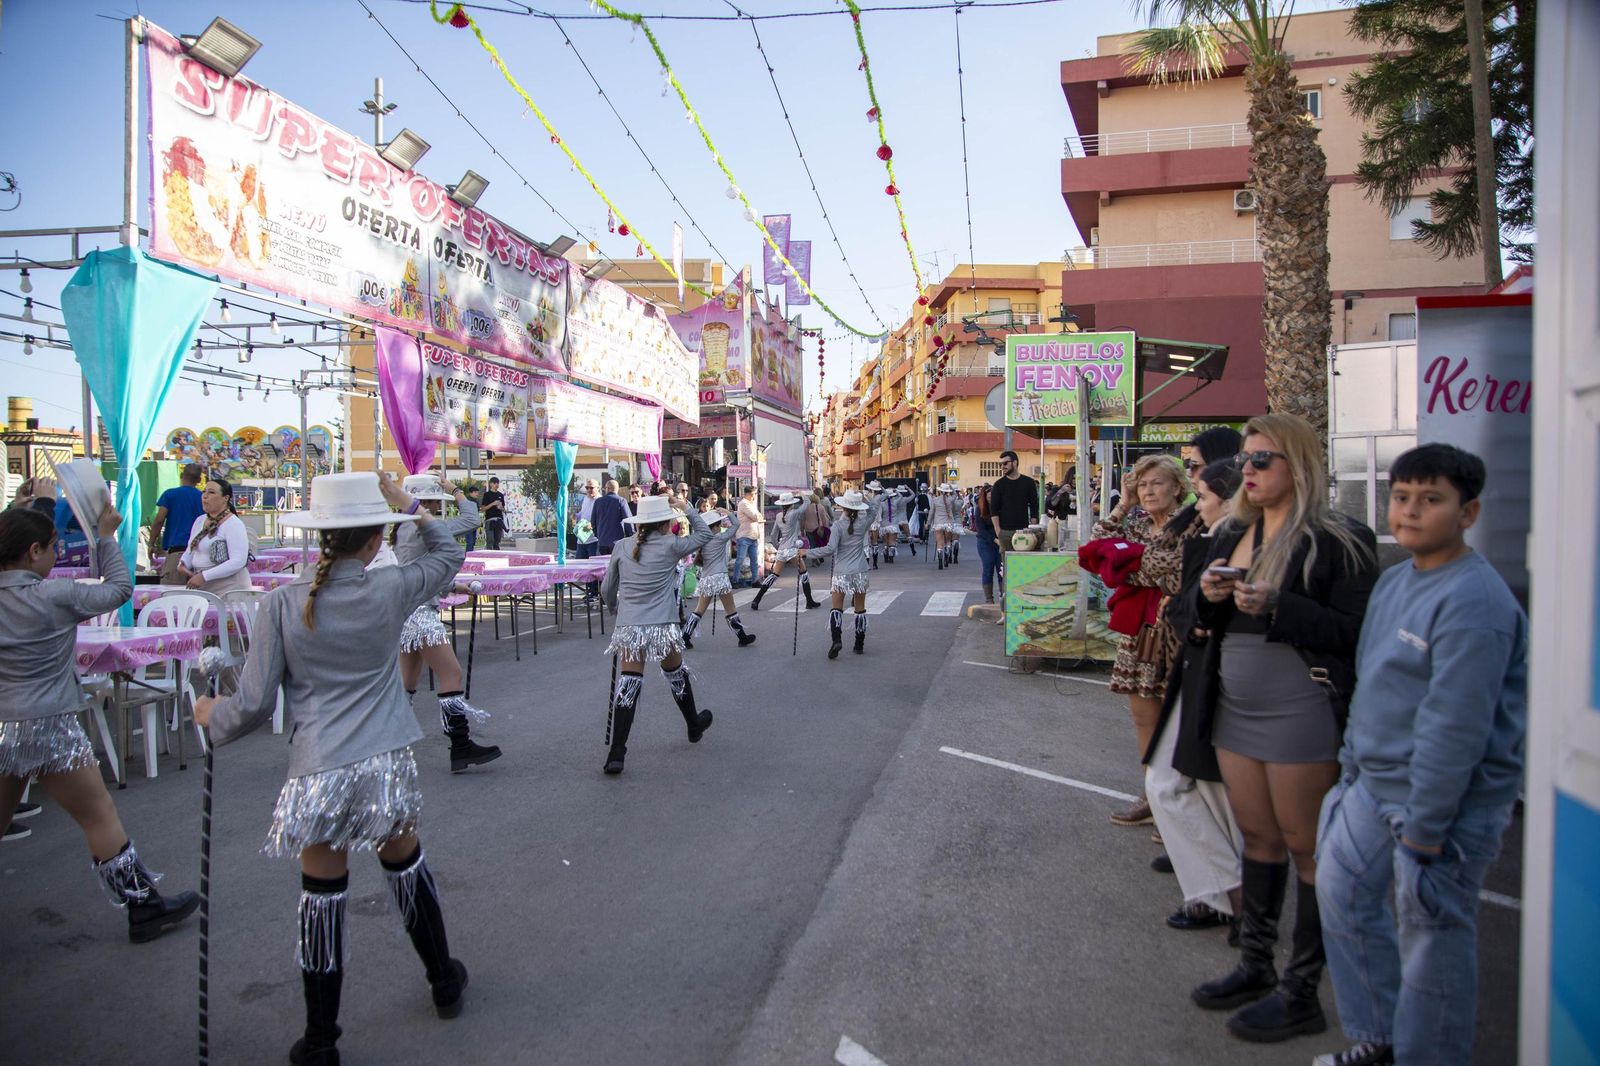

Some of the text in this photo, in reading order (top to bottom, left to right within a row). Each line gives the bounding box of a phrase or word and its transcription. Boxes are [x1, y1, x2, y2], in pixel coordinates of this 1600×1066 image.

[174, 58, 566, 288] SUPER OFERTAS
[342, 197, 421, 251] OFERTA
[433, 236, 494, 285] OFERTA
[424, 344, 529, 387] SUPER OFERTAS
[1016, 341, 1124, 361] BUÑUELOS
[446, 378, 478, 393] OFERTA
[481, 386, 505, 400] OFERTA
[1016, 363, 1124, 390] FENOY
